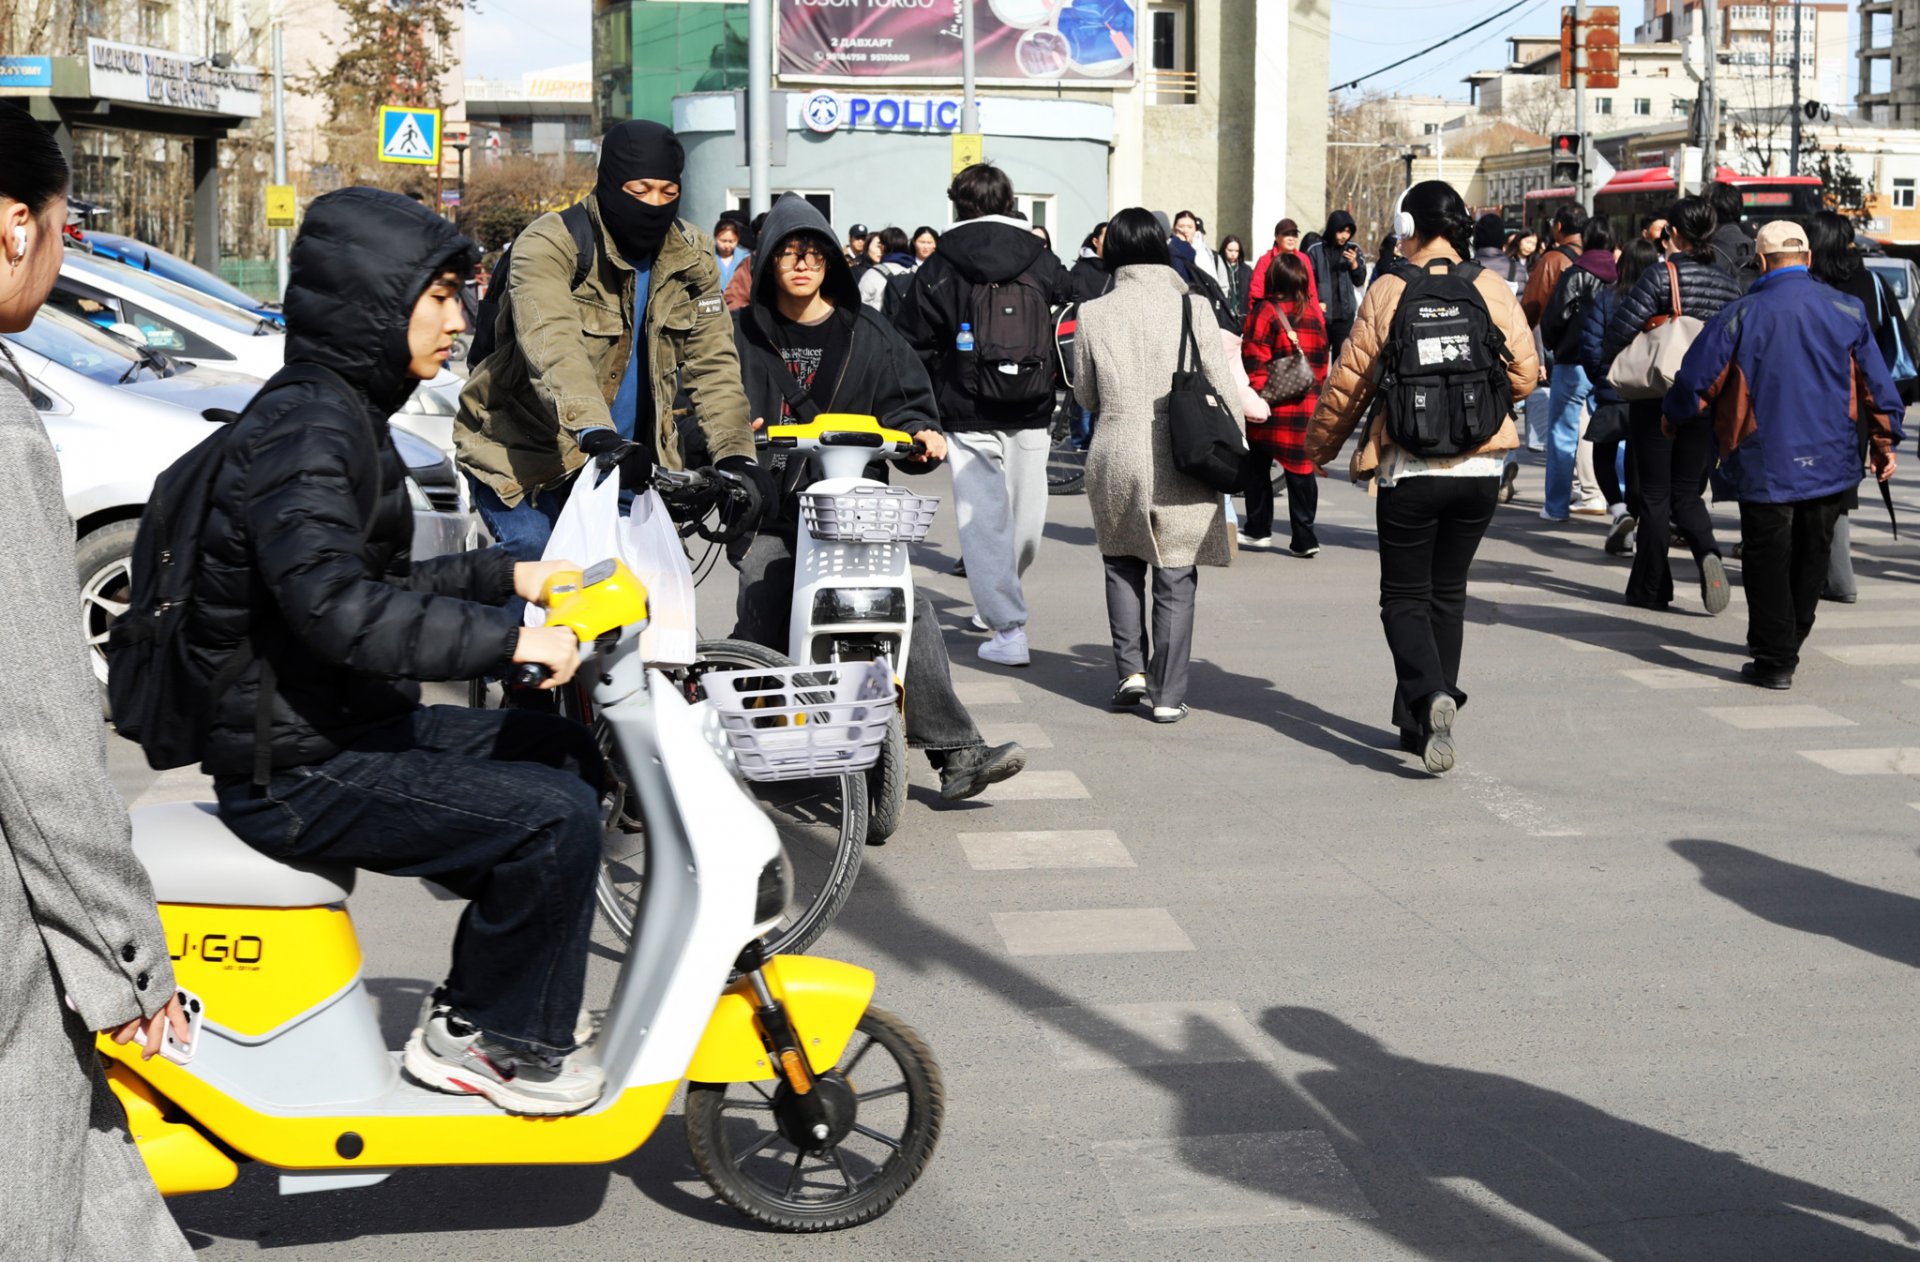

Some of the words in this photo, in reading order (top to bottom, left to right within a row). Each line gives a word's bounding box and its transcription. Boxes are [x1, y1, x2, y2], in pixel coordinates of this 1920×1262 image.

[831, 38, 839, 47] 2
[839, 38, 894, 48] ДАВХАРТ
[850, 98, 982, 129] POLIC
